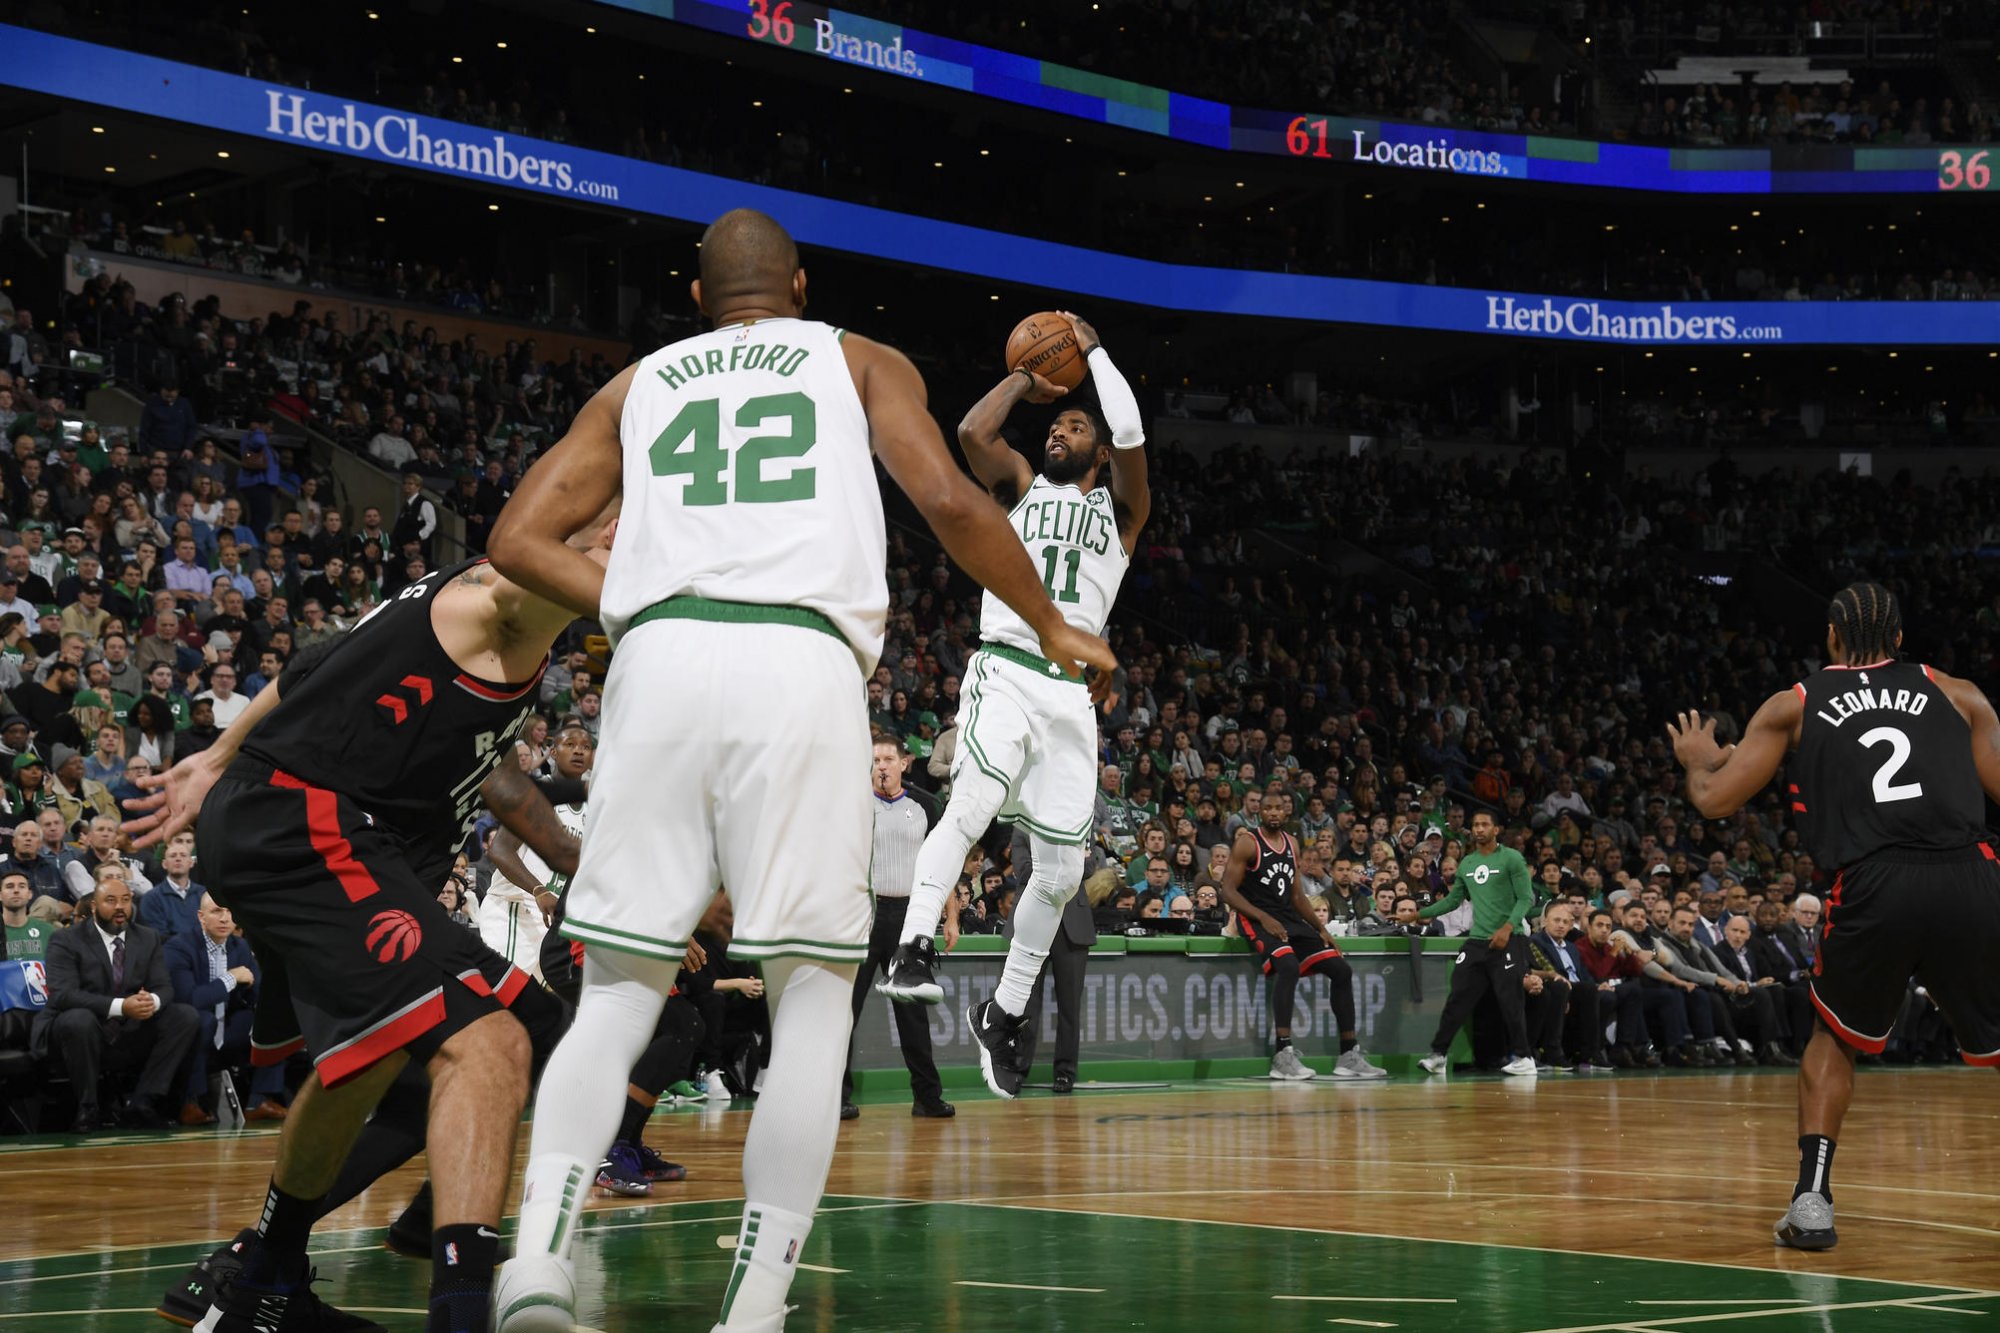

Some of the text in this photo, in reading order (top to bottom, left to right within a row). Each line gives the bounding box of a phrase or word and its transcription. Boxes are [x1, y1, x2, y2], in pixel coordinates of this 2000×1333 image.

[747, 0, 924, 77] 36 Brands.
[265, 90, 620, 200] HerbChambers.com
[1286, 116, 1509, 175] 61 Locations.
[1939, 150, 1990, 190] 36
[1486, 296, 1782, 341] HerbChambers.com
[656, 344, 810, 390] HORFORD
[648, 391, 817, 506] 42
[1023, 500, 1113, 556] CELTICS
[1041, 545, 1081, 604] 11
[1817, 688, 1929, 727] LEONARD
[1857, 726, 1923, 803] 2
[1277, 877, 1286, 897] 9
